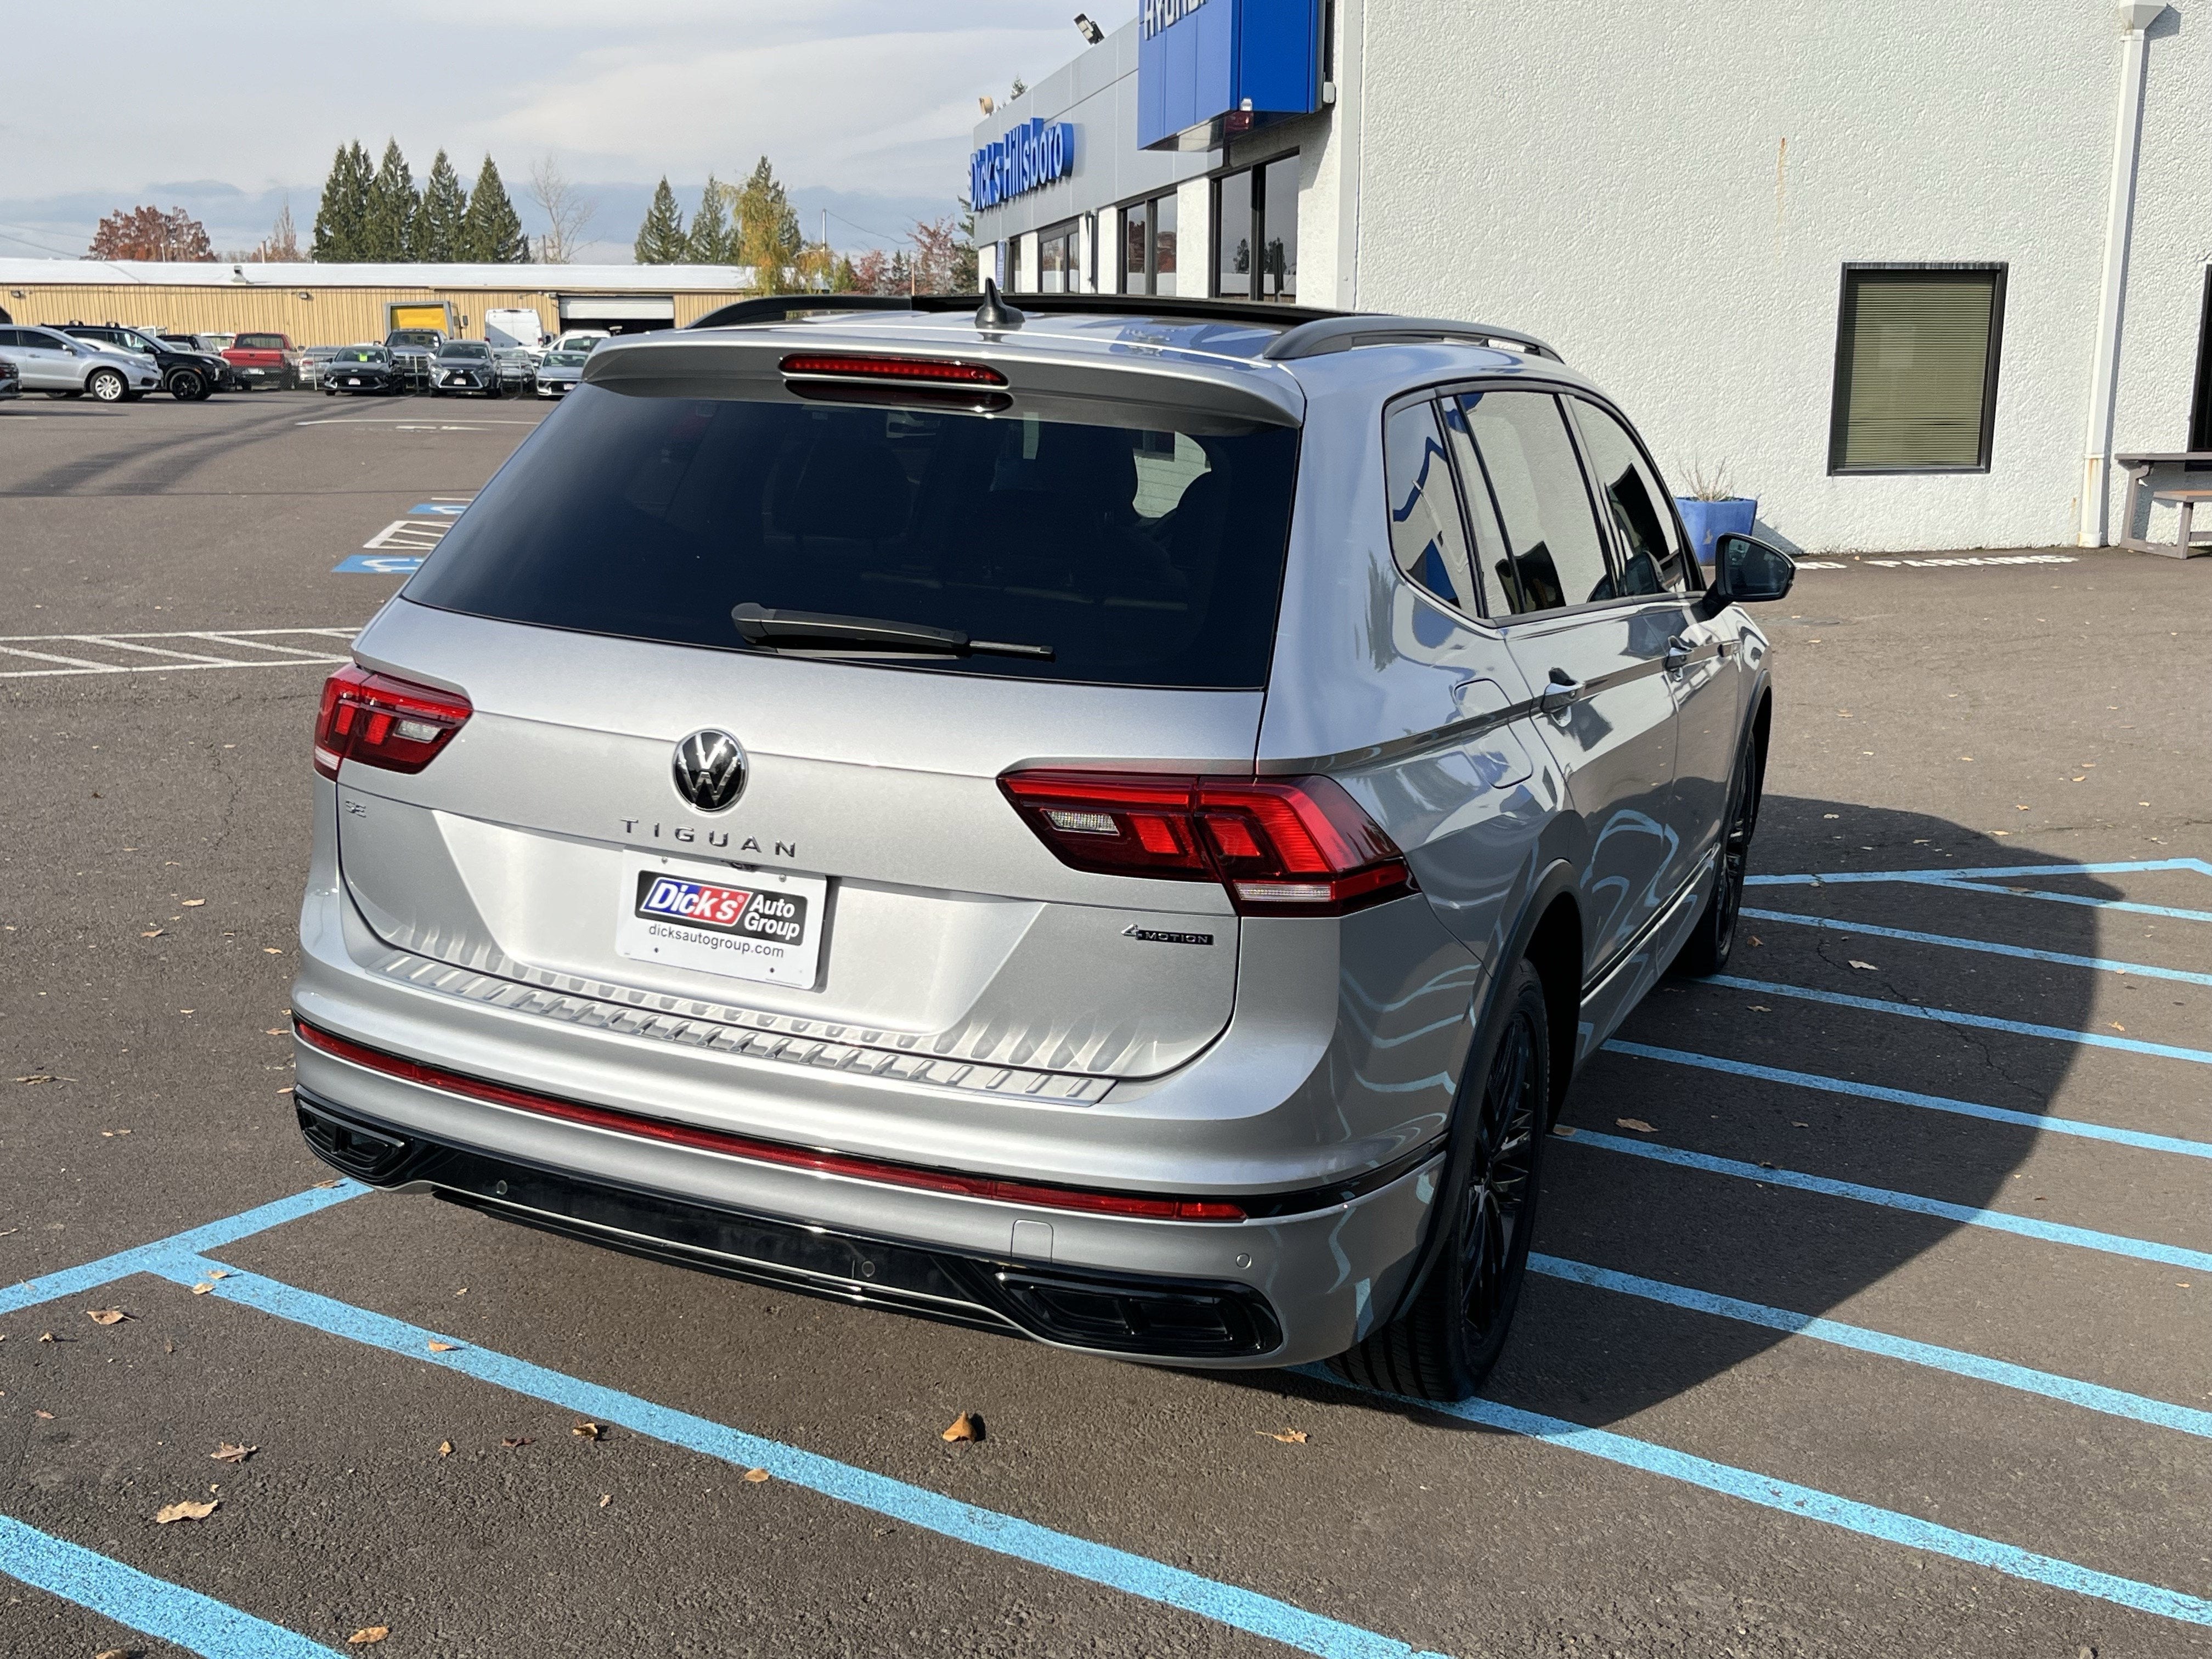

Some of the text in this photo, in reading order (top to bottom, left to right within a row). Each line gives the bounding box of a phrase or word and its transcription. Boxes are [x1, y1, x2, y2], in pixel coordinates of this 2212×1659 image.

[970, 117, 1066, 212] Dick's Hillsboro
[620, 817, 796, 858] TIGUAN
[648, 882, 738, 921] Dick's
[749, 894, 795, 918] Auto
[648, 923, 785, 958] dicksautogroup.com
[744, 911, 801, 940] Group
[1120, 923, 1209, 944] 4MOTION
